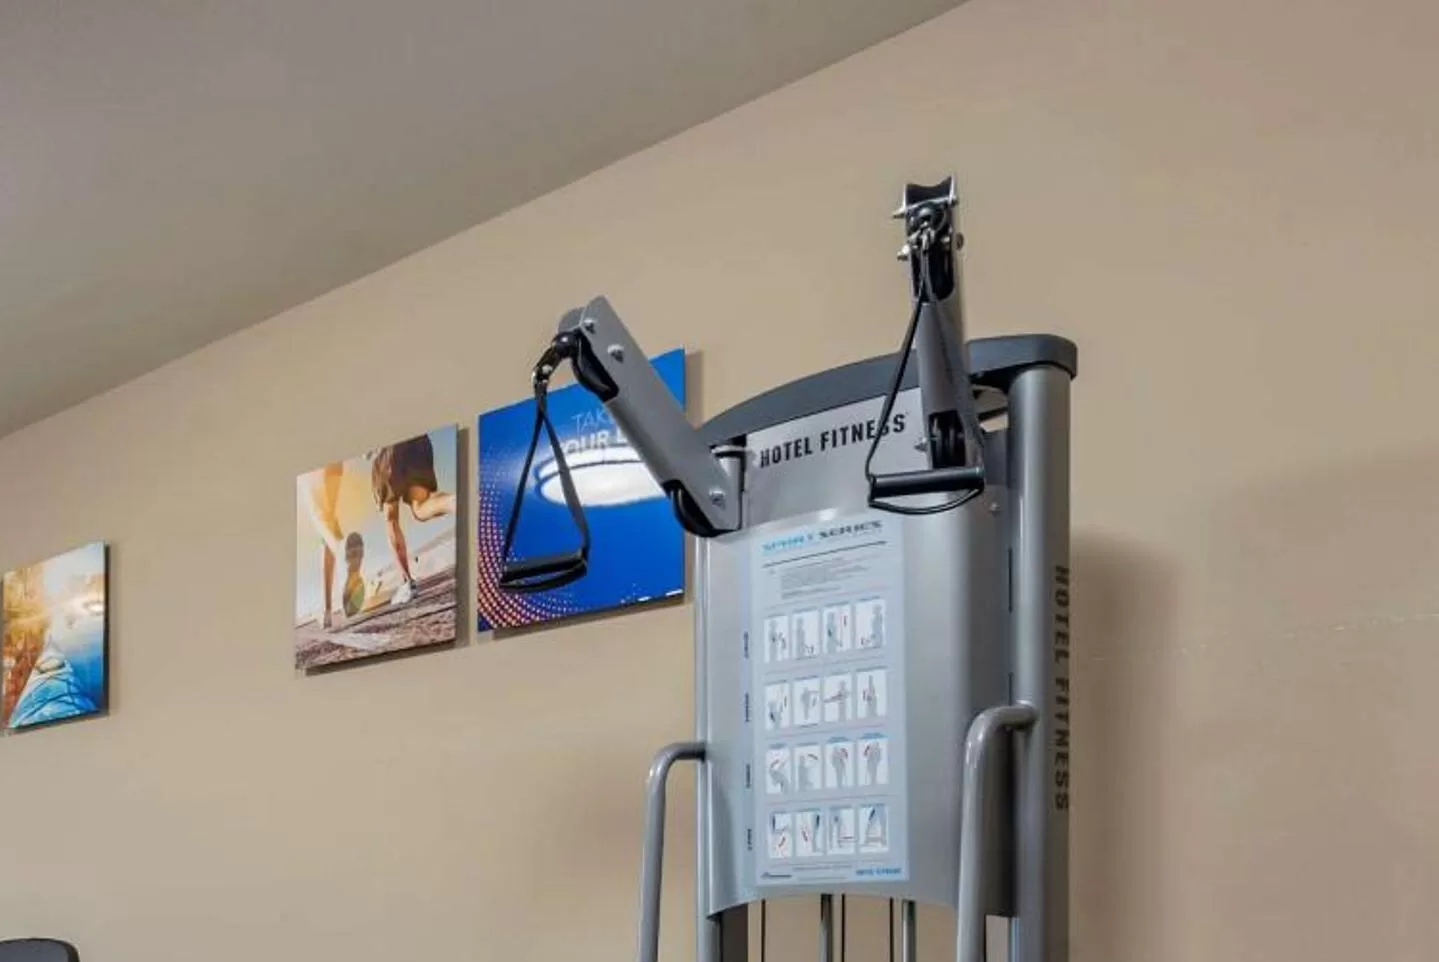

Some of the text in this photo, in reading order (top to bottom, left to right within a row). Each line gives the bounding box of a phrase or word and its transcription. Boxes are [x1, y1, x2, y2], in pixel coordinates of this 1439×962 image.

[572, 407, 616, 436] TAK
[760, 438, 813, 469] HOTEL
[1055, 565, 1070, 811] HOTEL FITNESS
